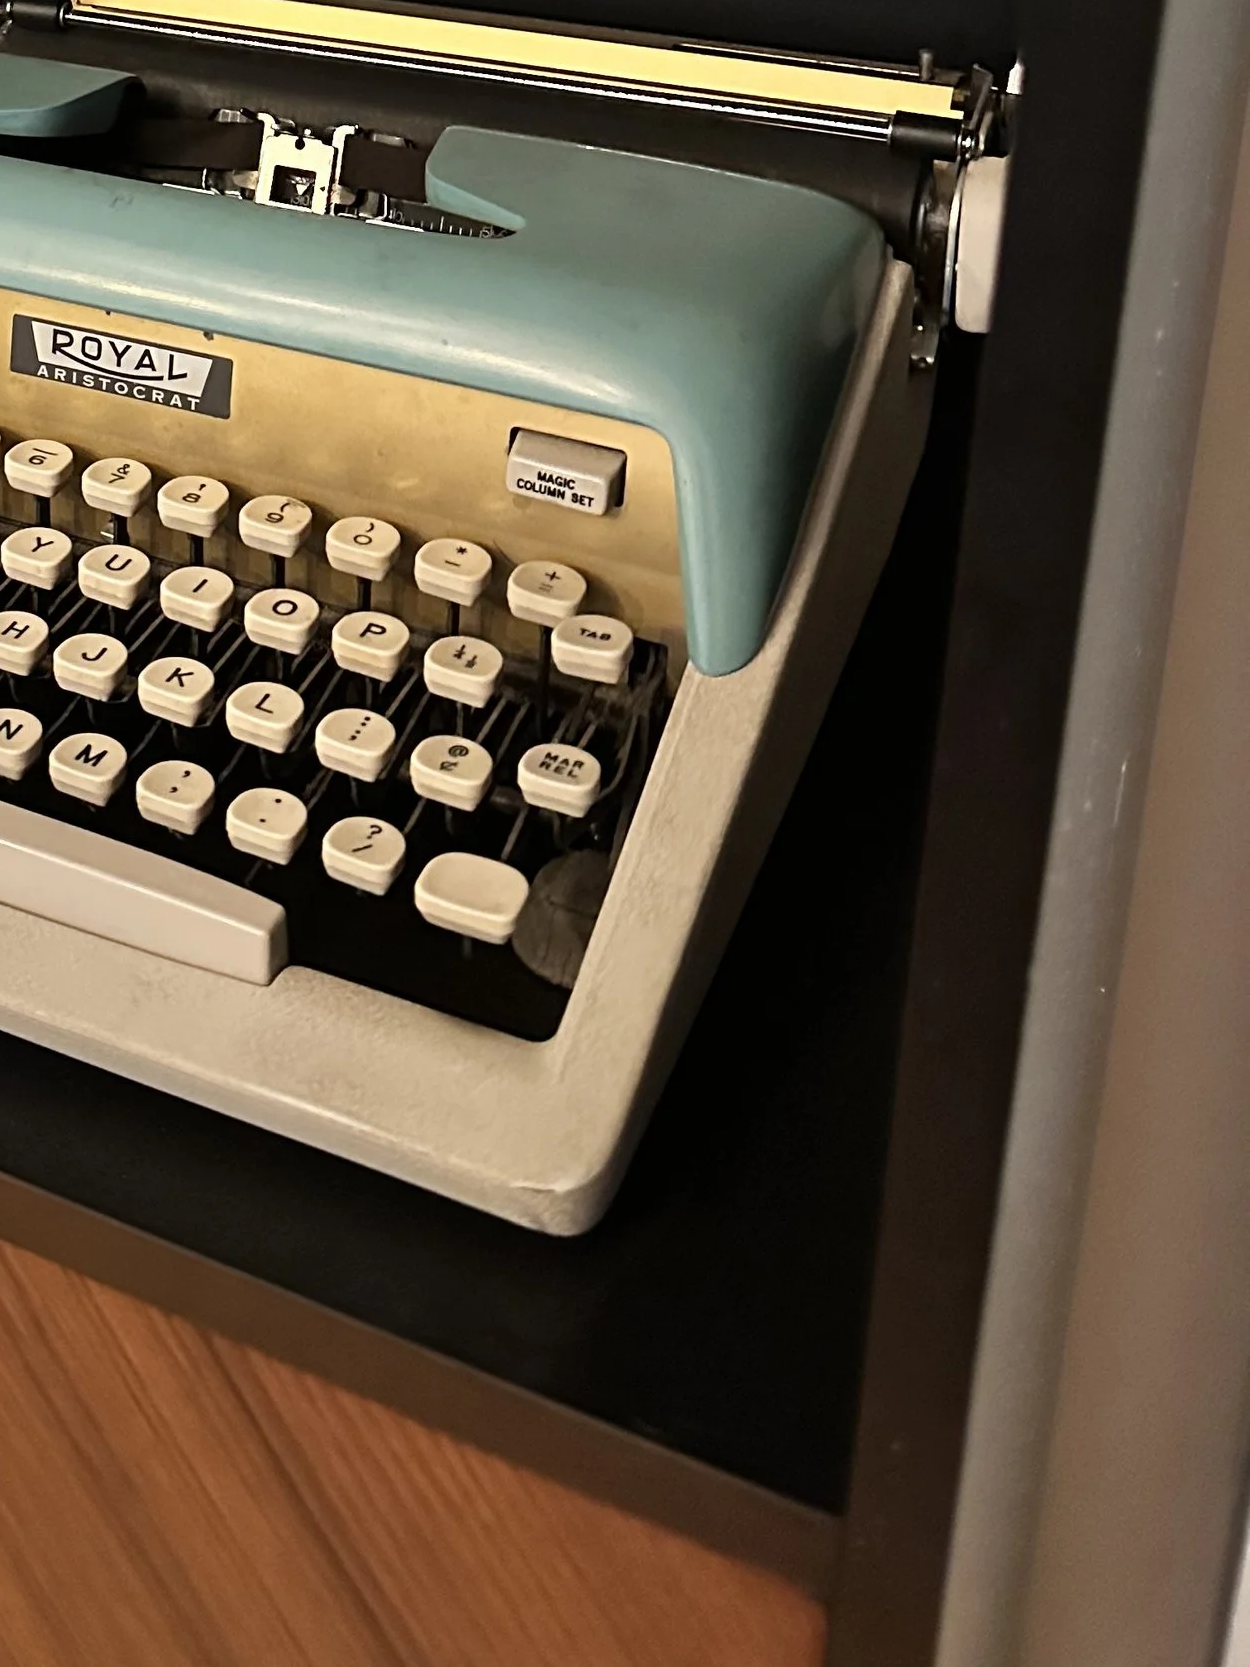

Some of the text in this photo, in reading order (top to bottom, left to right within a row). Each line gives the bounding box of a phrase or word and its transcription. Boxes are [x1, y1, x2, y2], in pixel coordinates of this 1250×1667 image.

[49, 329, 189, 382] ROYAL
[37, 364, 201, 412] ARISTOCRAT
[28, 454, 47, 466] 6
[537, 470, 576, 490] MAGIC
[182, 492, 202, 504] 8
[516, 478, 595, 508] COLUMN SET
[266, 512, 285, 524] 9
[32, 537, 54, 552] Y
[105, 554, 132, 571] U
[193, 579, 208, 593] I
[272, 600, 298, 616] O
[1, 621, 29, 639] H
[360, 623, 386, 638] P
[580, 628, 611, 641] TAB
[82, 648, 107, 661] J
[166, 668, 194, 687] K
[255, 694, 273, 713] L
[75, 744, 108, 767] M
[544, 751, 585, 770] MAR
